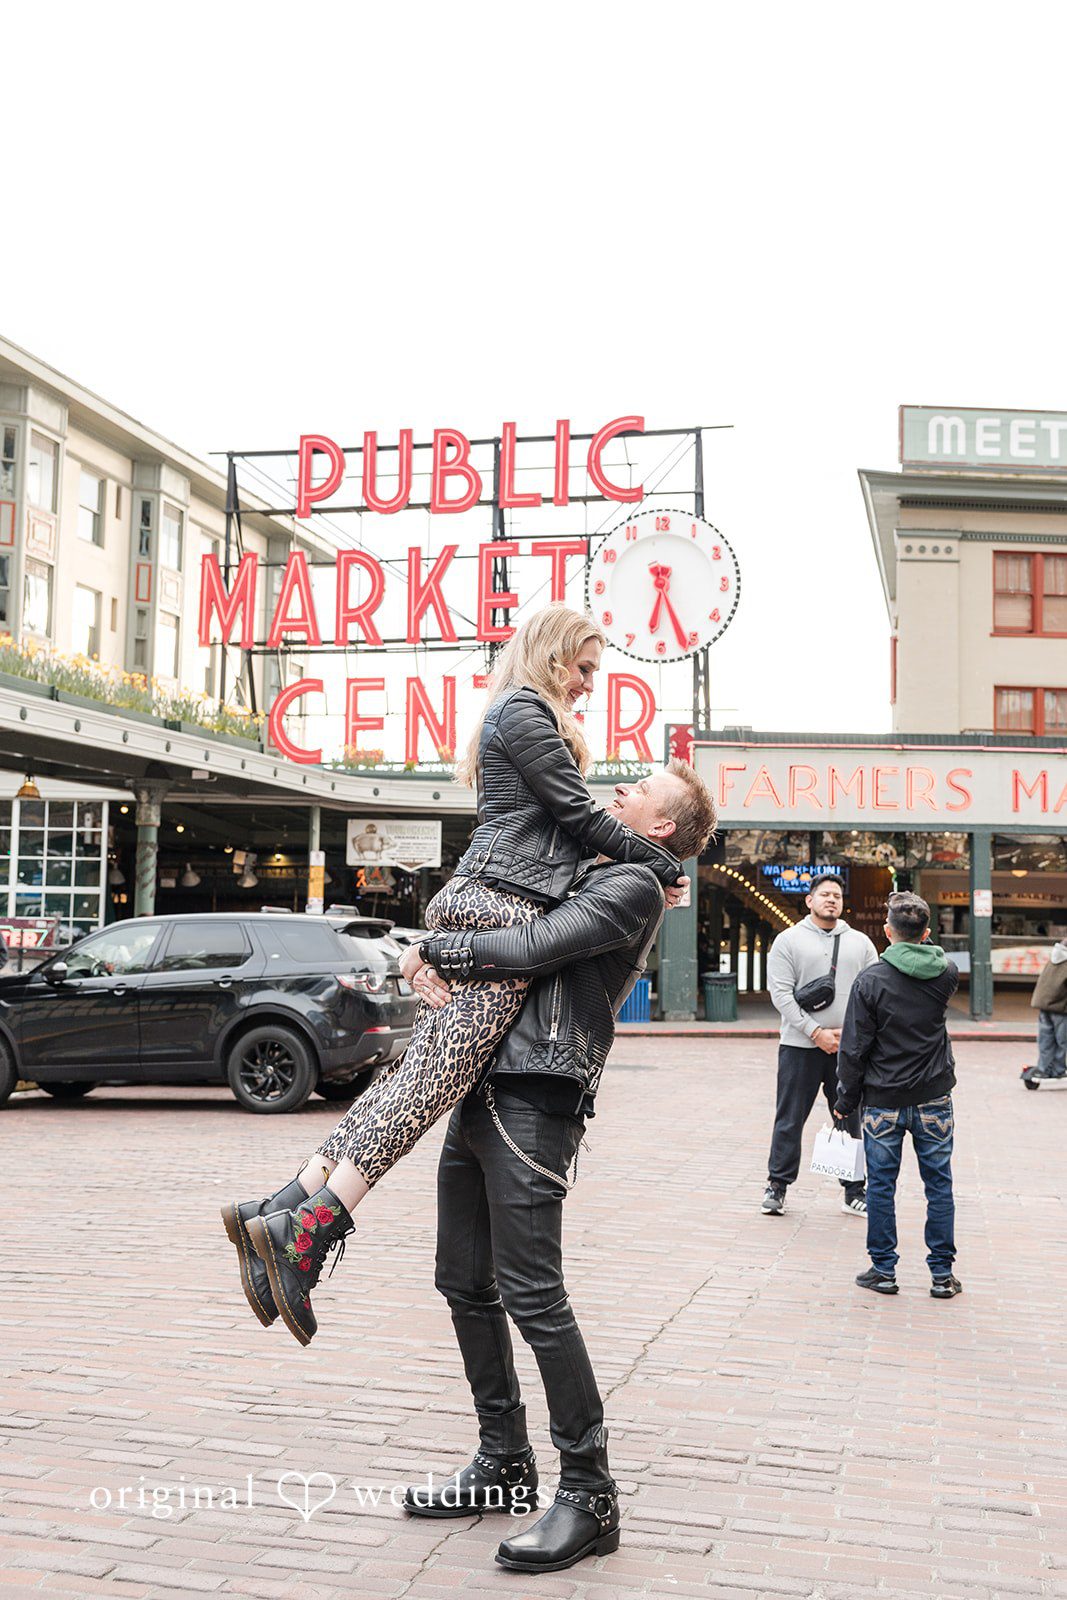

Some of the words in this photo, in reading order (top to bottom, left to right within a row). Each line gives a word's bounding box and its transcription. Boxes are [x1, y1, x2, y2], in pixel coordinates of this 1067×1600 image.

[928, 415, 1067, 459] MEET
[296, 415, 645, 519] PUBLIC
[655, 516, 671, 531] 12
[691, 523, 697, 539] 1
[625, 525, 638, 541] 11
[603, 549, 617, 563] 10
[712, 545, 722, 560] 2
[594, 580, 605, 595] 9
[720, 576, 729, 592] 3
[198, 539, 588, 648] MARKET
[602, 611, 613, 626] 8
[709, 608, 721, 623] 4
[625, 633, 636, 648] 7
[688, 632, 699, 646] 5
[655, 640, 667, 655] 6
[268, 672, 656, 764] CENR
[718, 763, 973, 812] FARMERS
[1012, 769, 1067, 813] M
[811, 1163, 852, 1178] PANDORA
